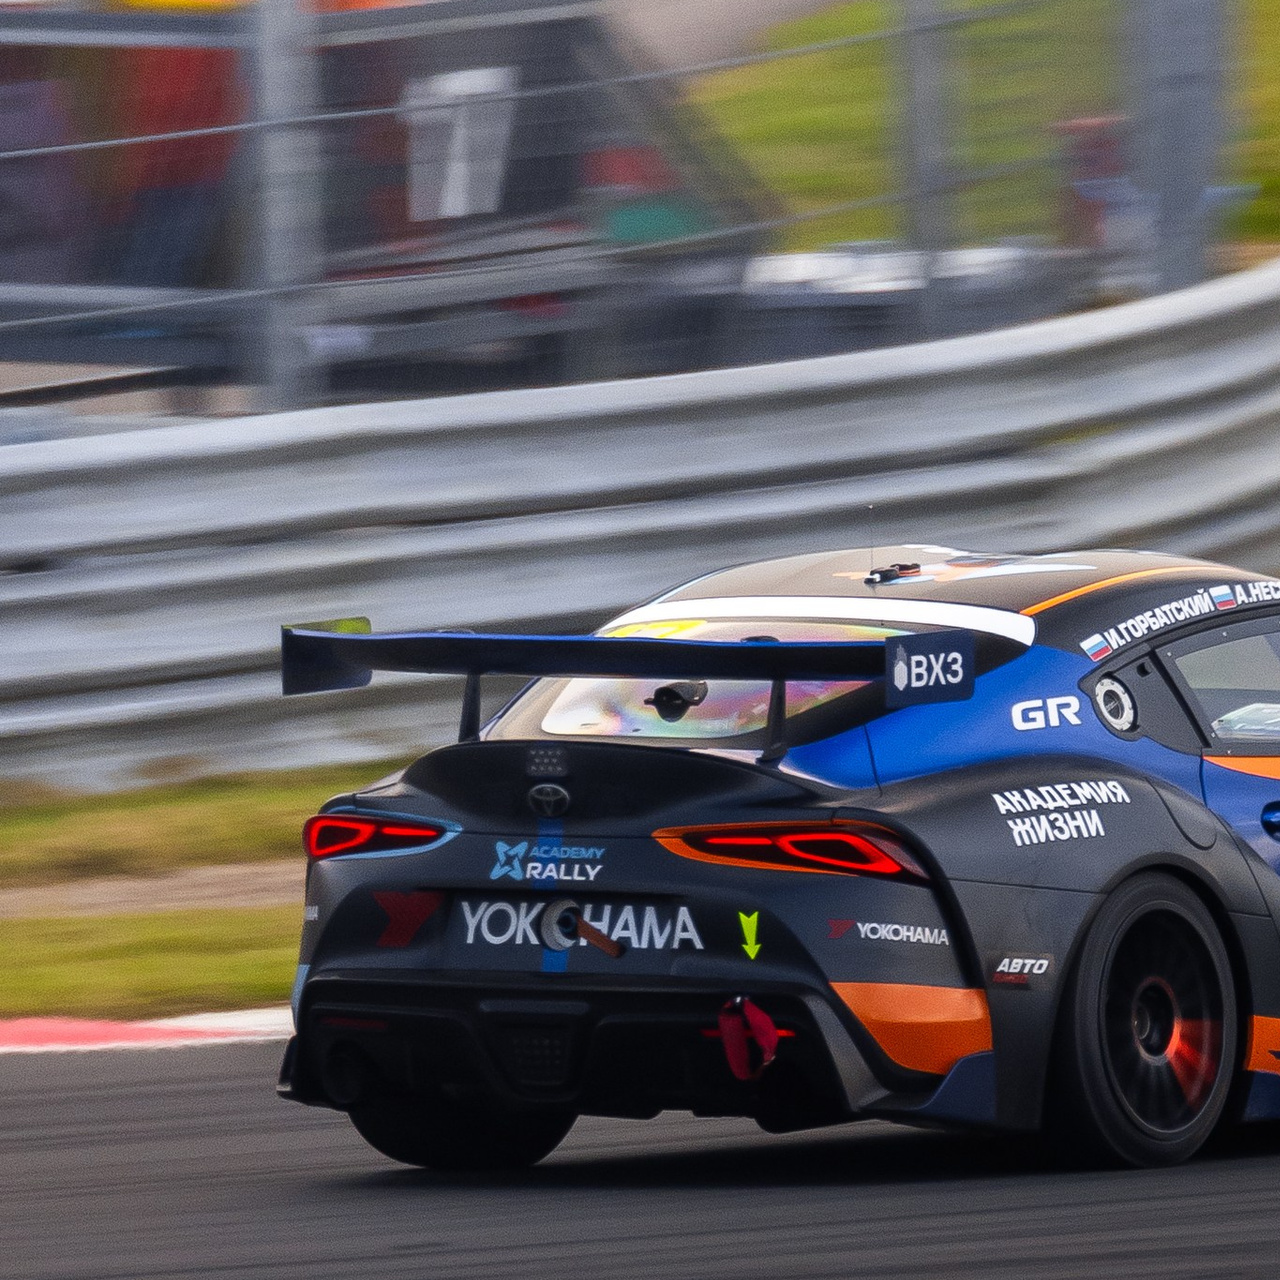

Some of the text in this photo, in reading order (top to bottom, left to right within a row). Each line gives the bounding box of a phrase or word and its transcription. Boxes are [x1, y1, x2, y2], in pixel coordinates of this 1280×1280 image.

[1104, 588, 1216, 650] И.ГОРБАТСКИЙ
[1011, 695, 1083, 731] GR
[991, 780, 1131, 815] АКАДЕМИЯ
[1007, 809, 1106, 847] ЖИЗНИ
[528, 846, 606, 859] ACADEMY
[525, 862, 604, 882] RALLY
[461, 901, 705, 950] YOKHAMA
[857, 922, 950, 946] YOKOHAMA
